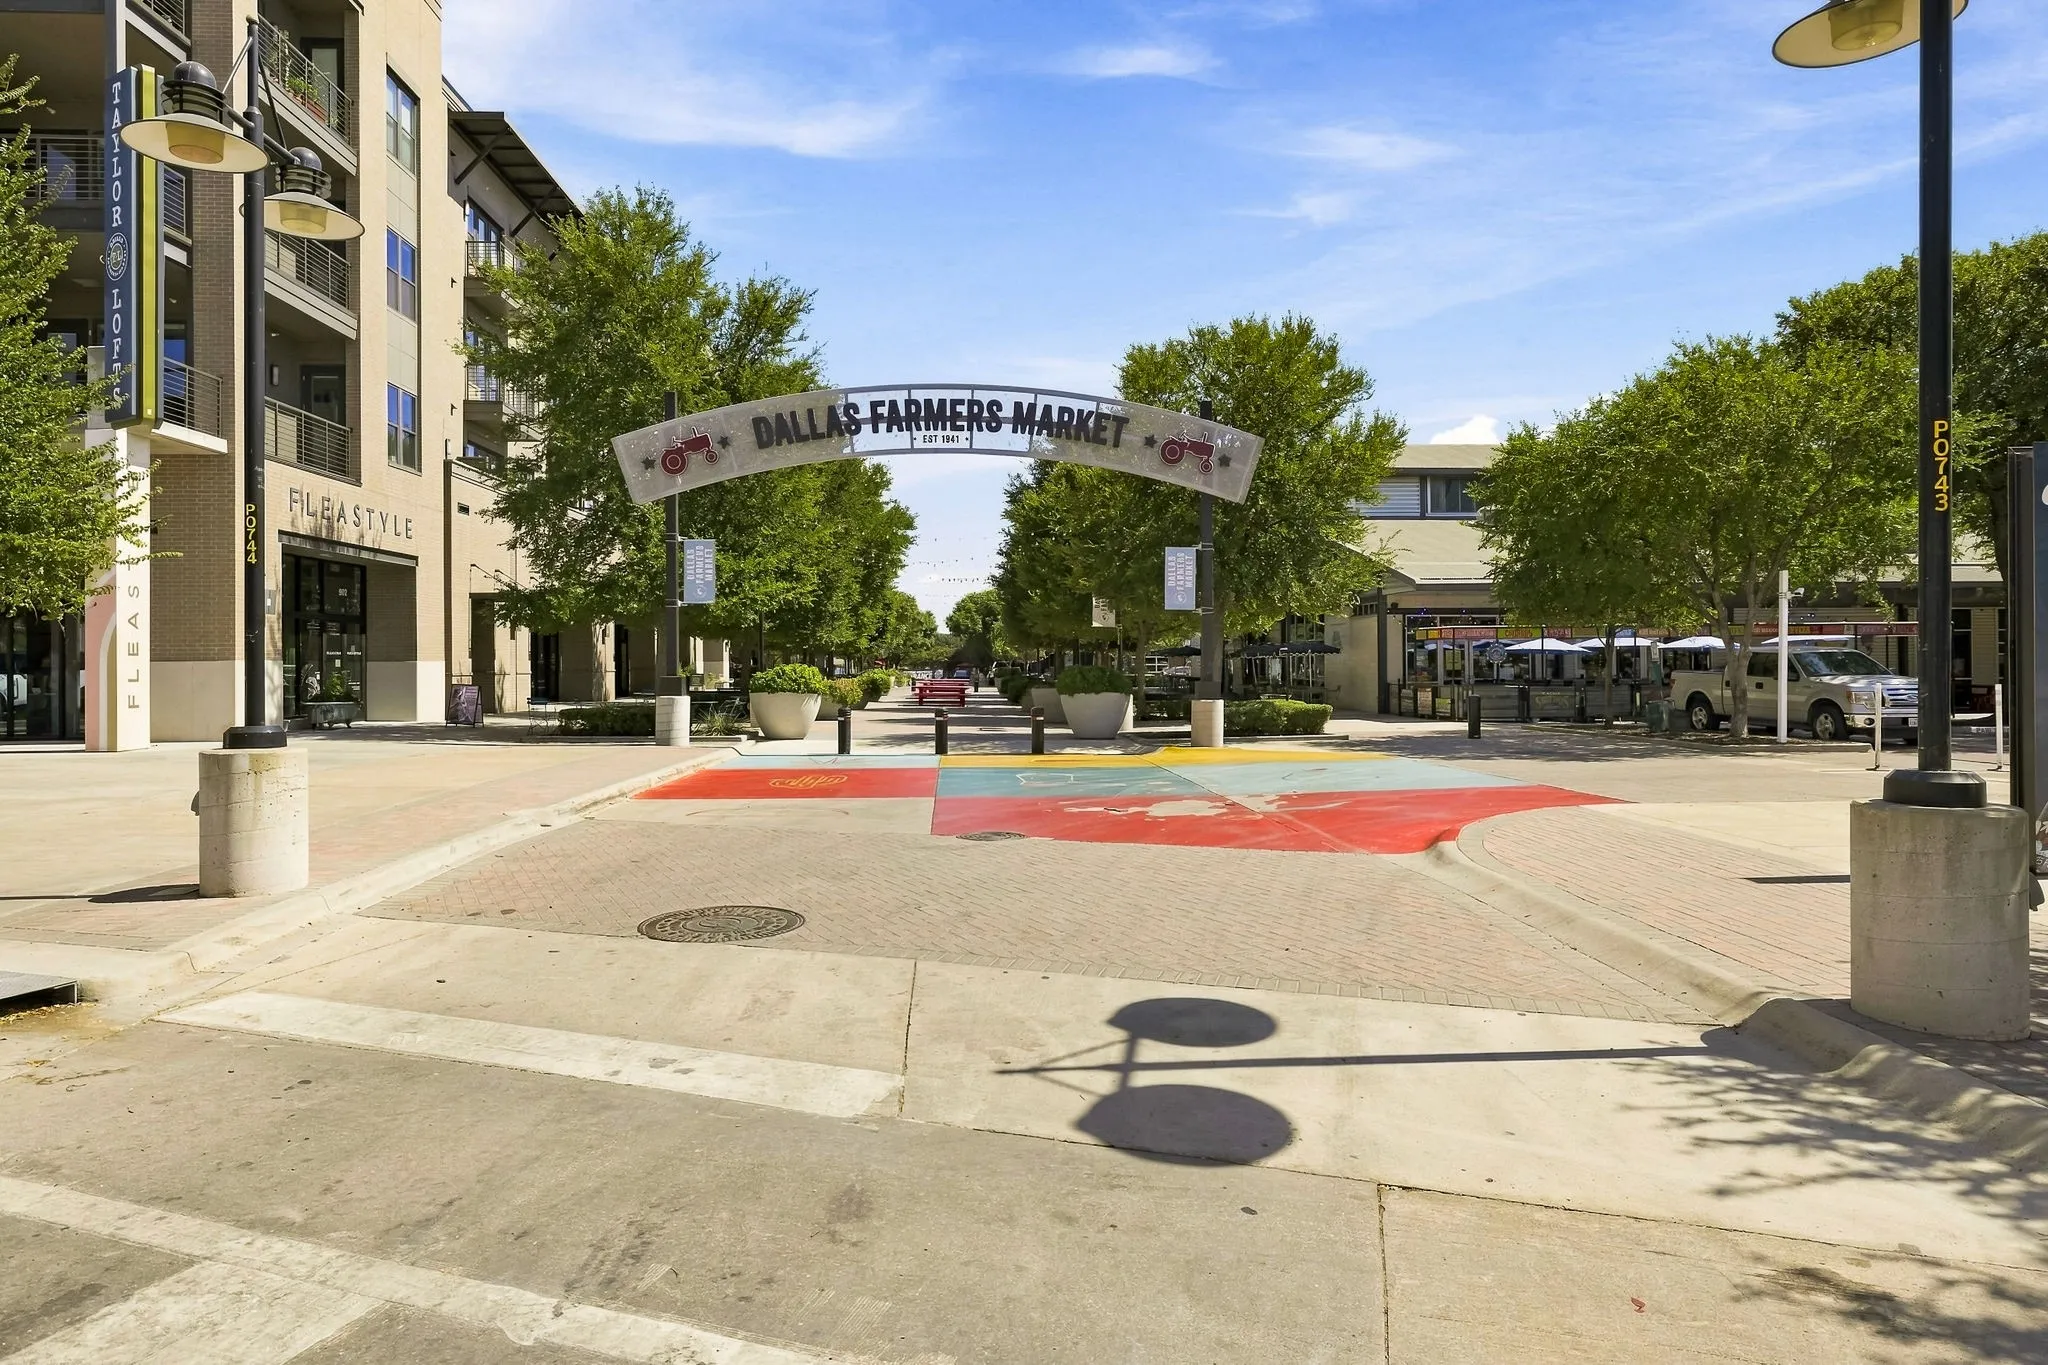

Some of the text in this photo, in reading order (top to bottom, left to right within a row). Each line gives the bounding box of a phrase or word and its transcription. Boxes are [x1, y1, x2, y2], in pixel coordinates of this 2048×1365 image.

[111, 81, 122, 228] TAYLOR
[751, 398, 1130, 450] DALLAS FARMERS MARKET
[923, 434, 959, 443] EST 1941
[289, 487, 413, 540] FLEASTYLE
[686, 549, 695, 580] DALLAS
[695, 545, 704, 584] FARMERS
[704, 549, 713, 581] MARKET
[1167, 556, 1176, 587] DALLAS
[1176, 552, 1185, 590] FARMERS
[1185, 556, 1193, 588] MARKET
